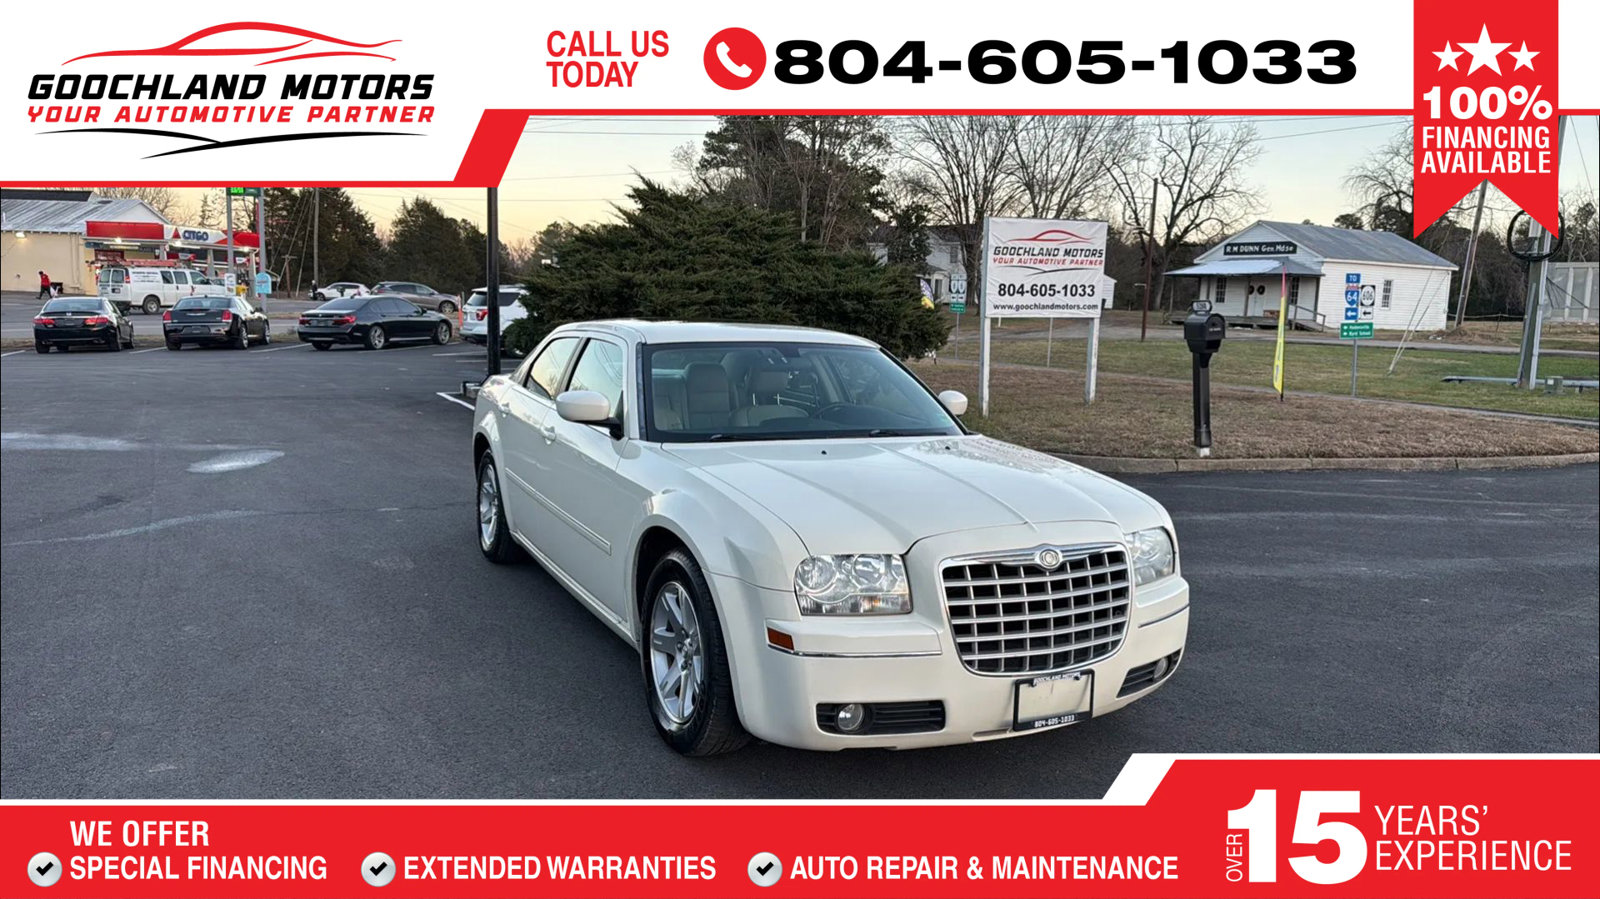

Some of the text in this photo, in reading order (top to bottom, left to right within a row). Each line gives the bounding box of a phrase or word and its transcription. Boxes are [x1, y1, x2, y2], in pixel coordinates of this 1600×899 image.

[182, 229, 209, 242] CITGO
[993, 246, 1104, 258] GOOCHLAND MOTORS
[1240, 245, 1260, 253] DUNN
[993, 257, 1015, 265] YOUR
[998, 283, 1096, 297] 804-605-1033
[1346, 291, 1358, 302] 64
[993, 302, 1099, 311] www.goochlandmotors.com
[1034, 714, 1075, 728] 804-605-1033
